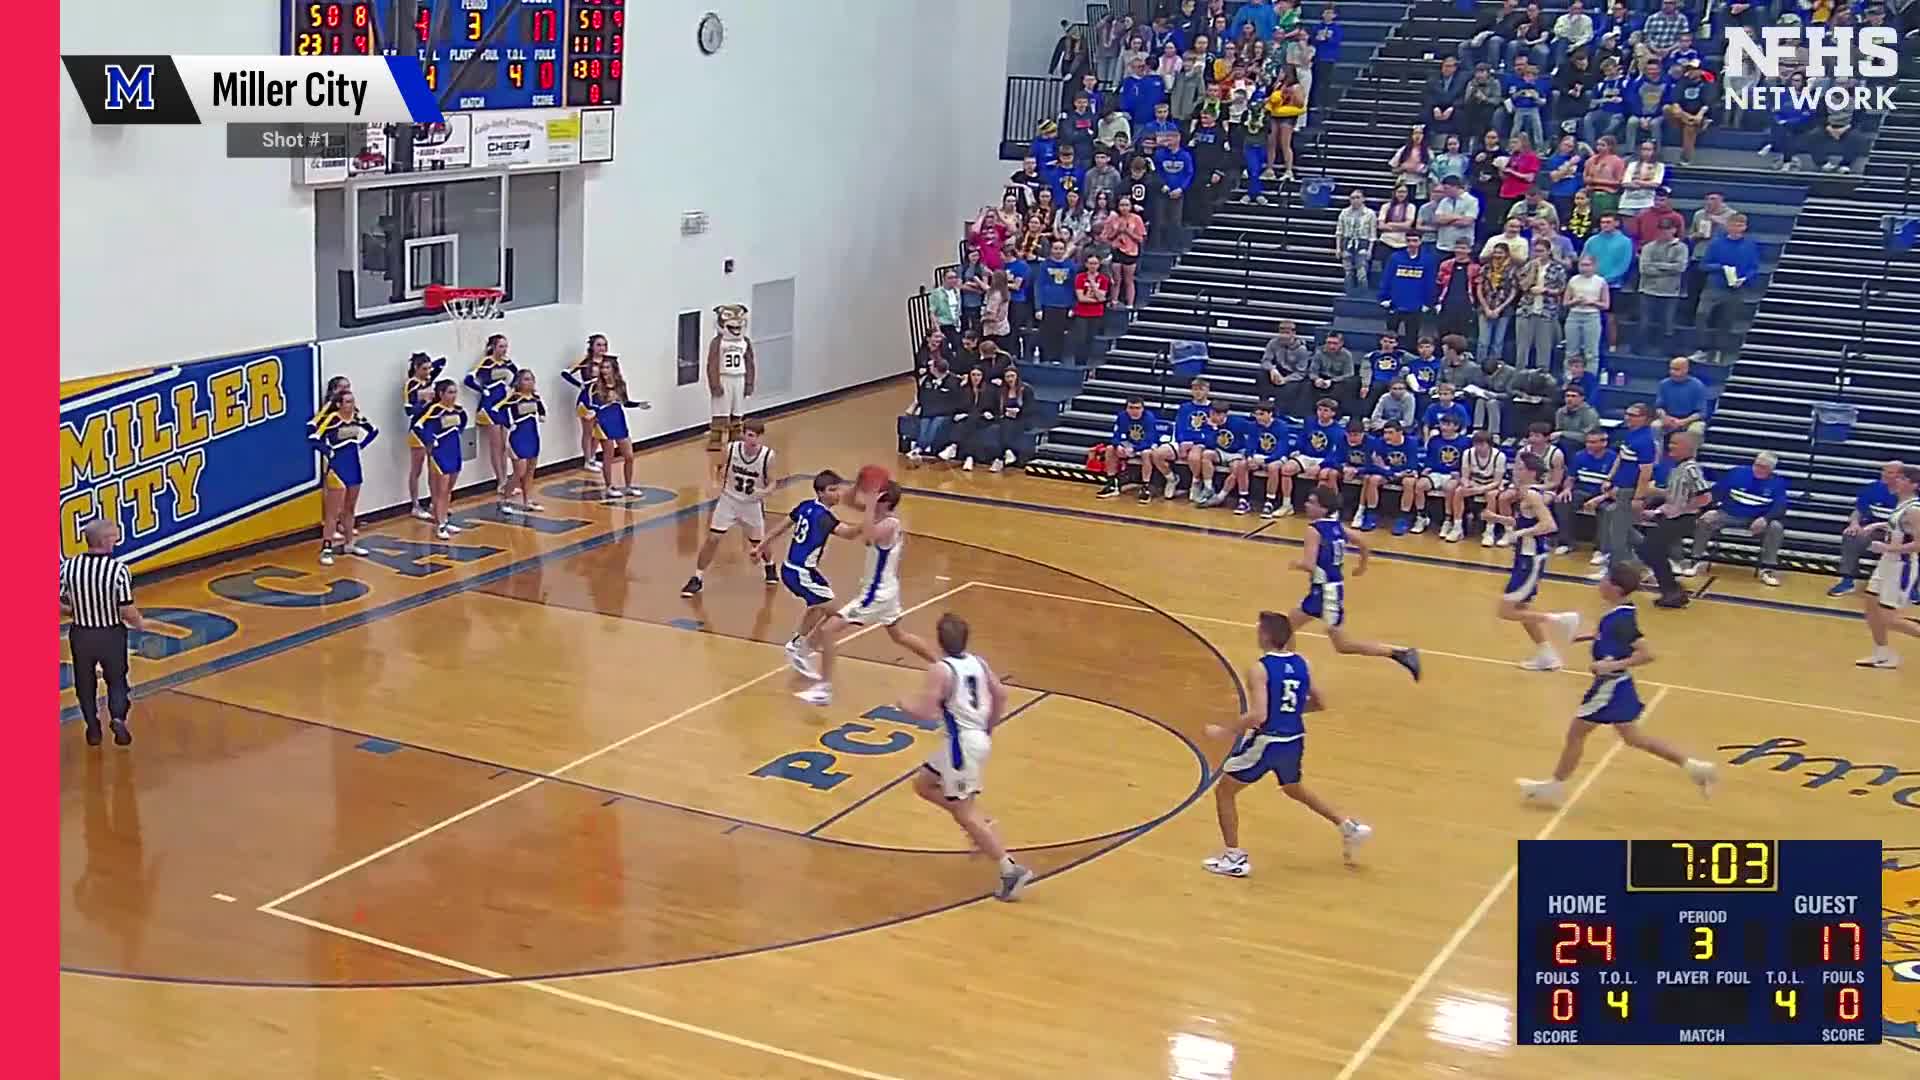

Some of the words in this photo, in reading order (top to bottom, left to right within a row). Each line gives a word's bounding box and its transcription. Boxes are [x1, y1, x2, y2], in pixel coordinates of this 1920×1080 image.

[310, 5, 322, 27] 5
[468, 12, 481, 40] 3
[580, 10, 590, 29] 5
[299, 34, 322, 55] 23
[509, 64, 522, 87] 4
[725, 354, 741, 368] 30
[60, 357, 286, 492] MILLER
[60, 449, 205, 560] CITY
[1280, 679, 1301, 713] 5
